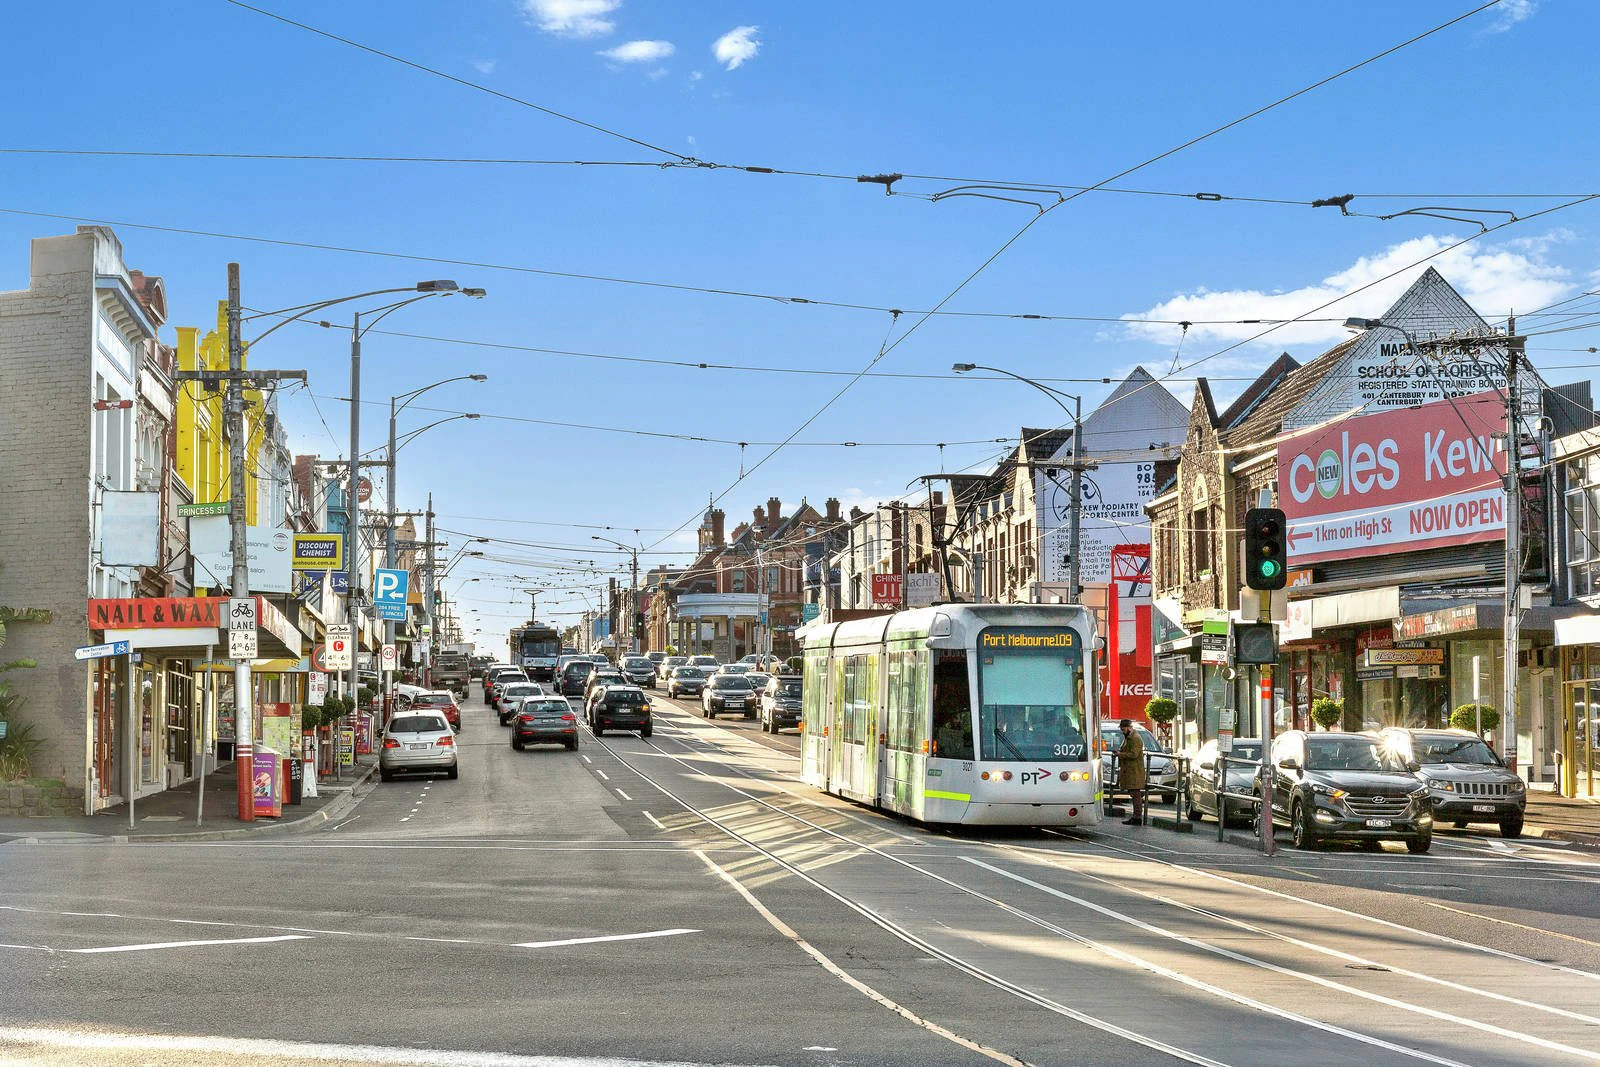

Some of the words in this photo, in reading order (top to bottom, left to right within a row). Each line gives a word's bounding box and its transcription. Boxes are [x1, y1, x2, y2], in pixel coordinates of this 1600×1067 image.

[1357, 365, 1411, 379] SCHOOL
[1358, 381, 1408, 391] REGISTERED
[1411, 380, 1438, 390] STATE
[1440, 379, 1476, 389] TRAINING
[1478, 379, 1507, 388] BOARD
[1361, 392, 1375, 400] 401
[1379, 391, 1426, 399] CANTERBURY
[1376, 398, 1424, 406] CANTERBURY
[1424, 429, 1495, 482] Kew
[1317, 464, 1340, 482] NEW
[178, 506, 214, 516] PRINCESS
[216, 506, 226, 514] ST
[1101, 502, 1139, 511] PODIATRY
[1111, 510, 1140, 518] CENTRE
[1409, 503, 1452, 534] NOW
[1454, 496, 1502, 528] OPEN
[1315, 526, 1320, 542] 1
[1321, 525, 1338, 541] km
[1340, 526, 1353, 539] on
[1355, 519, 1379, 540] High
[1381, 517, 1392, 534] St
[298, 542, 335, 550] DISCOUNT
[377, 572, 398, 599] P
[96, 603, 147, 624] NAIL
[152, 604, 165, 623] &
[170, 601, 216, 623] WAX
[231, 621, 255, 630] LANE
[983, 633, 1006, 647] Port
[384, 649, 393, 657] 40
[1053, 744, 1084, 756] 3027
